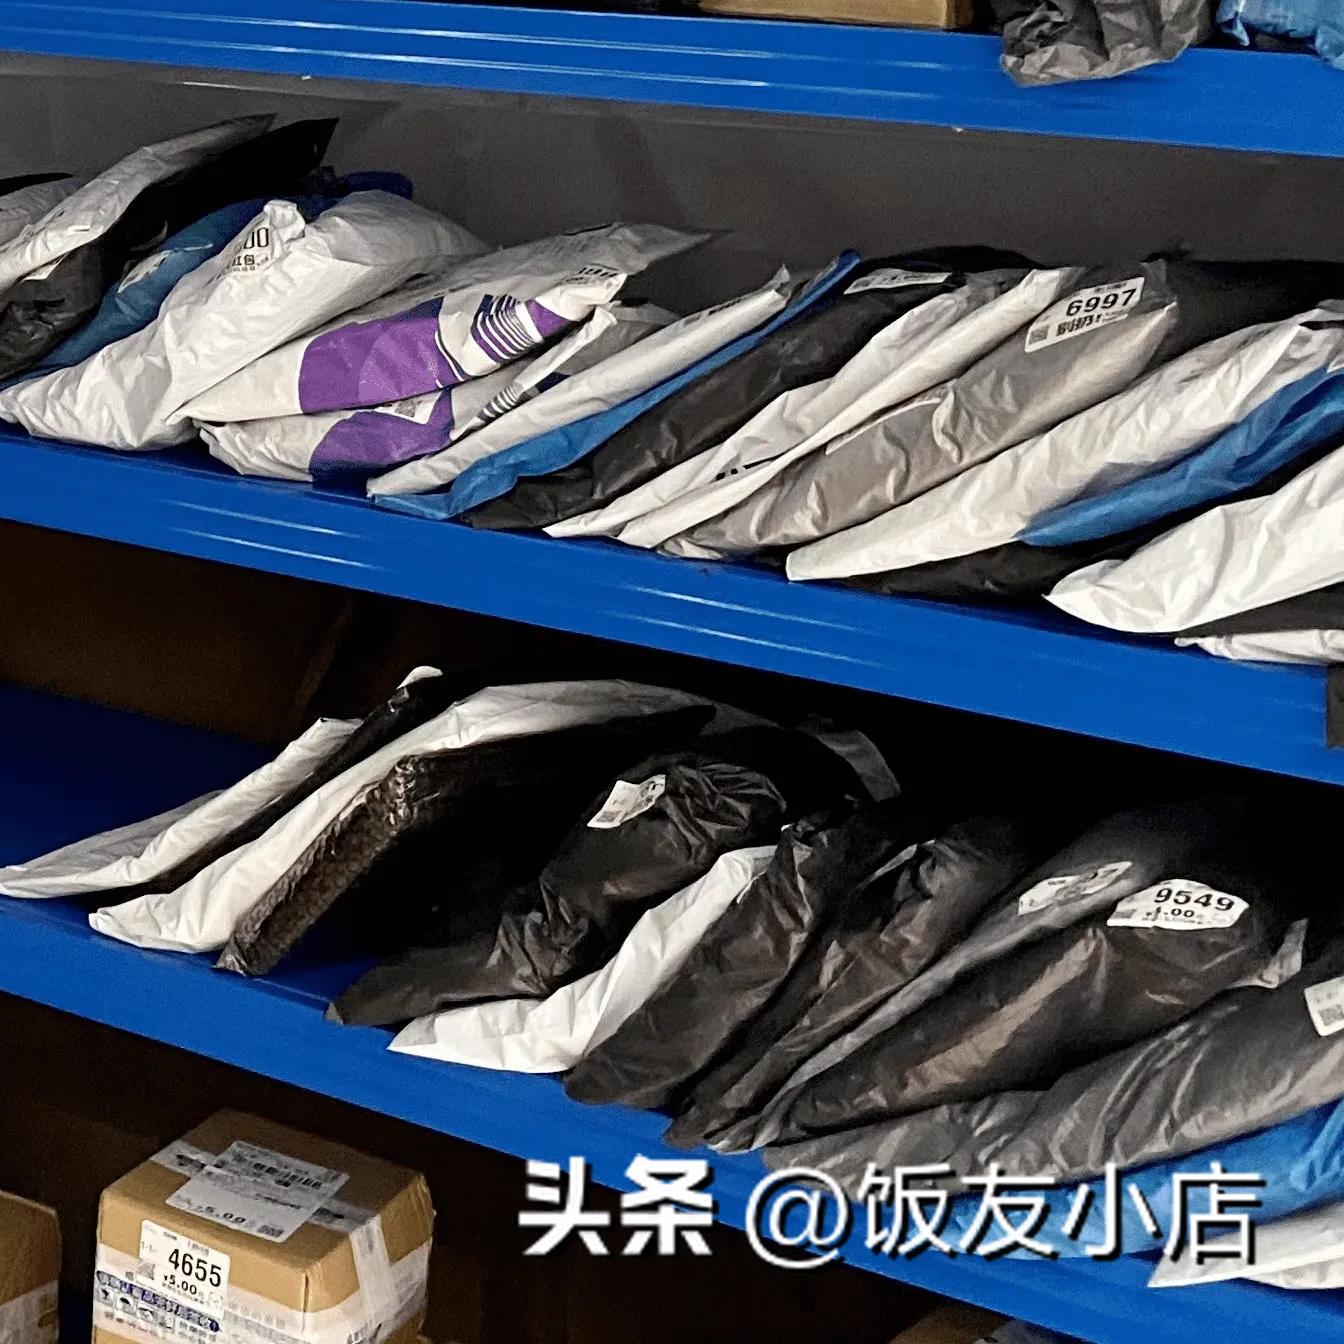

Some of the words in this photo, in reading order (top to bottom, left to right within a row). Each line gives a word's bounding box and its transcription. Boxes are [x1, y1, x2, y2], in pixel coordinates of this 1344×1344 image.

[1066, 289, 1137, 316] 6997
[1154, 885, 1235, 912] 9549
[168, 1248, 222, 1287] 4655
